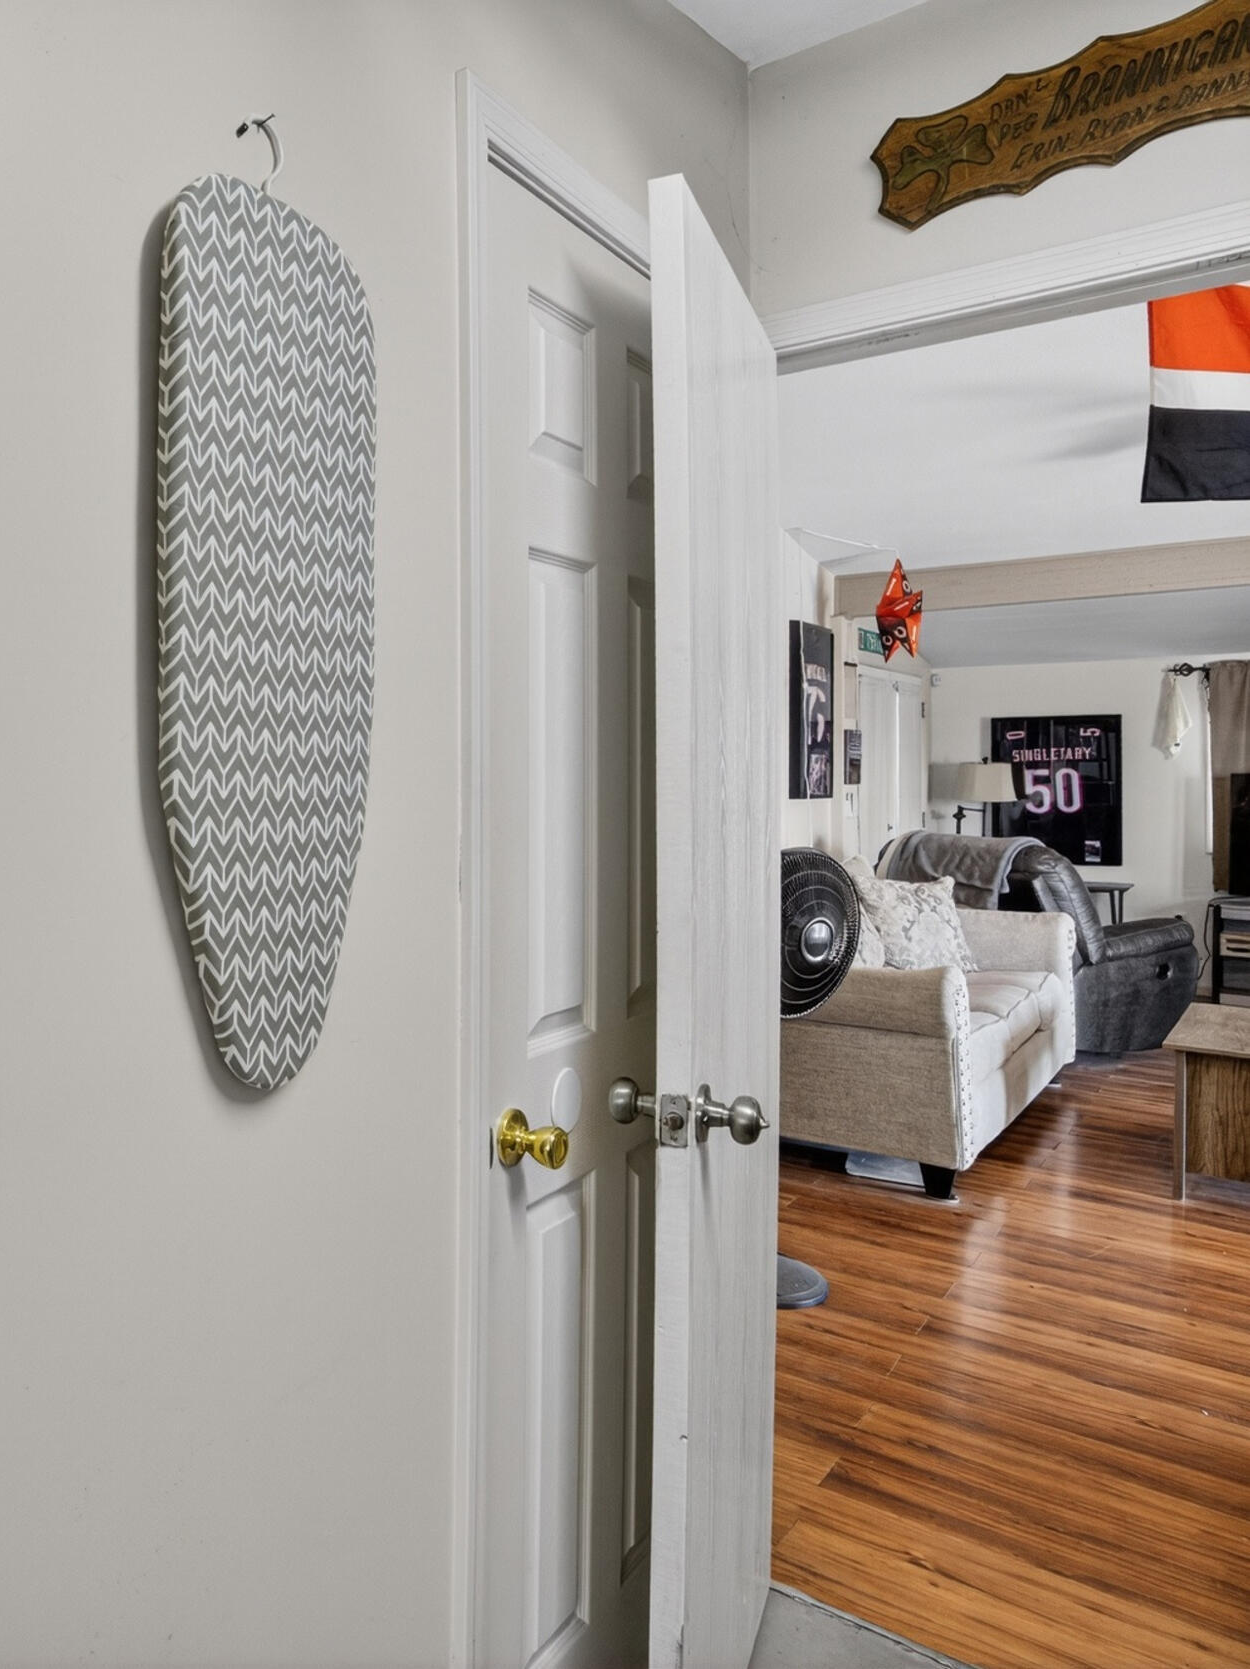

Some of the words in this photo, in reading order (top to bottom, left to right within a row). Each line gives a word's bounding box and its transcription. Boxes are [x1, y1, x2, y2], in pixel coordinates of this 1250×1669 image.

[1173, 70, 1250, 110] DANN
[999, 112, 1038, 147] PEG
[1012, 747, 1092, 762] SINGLETARY
[1024, 767, 1083, 814] 50
